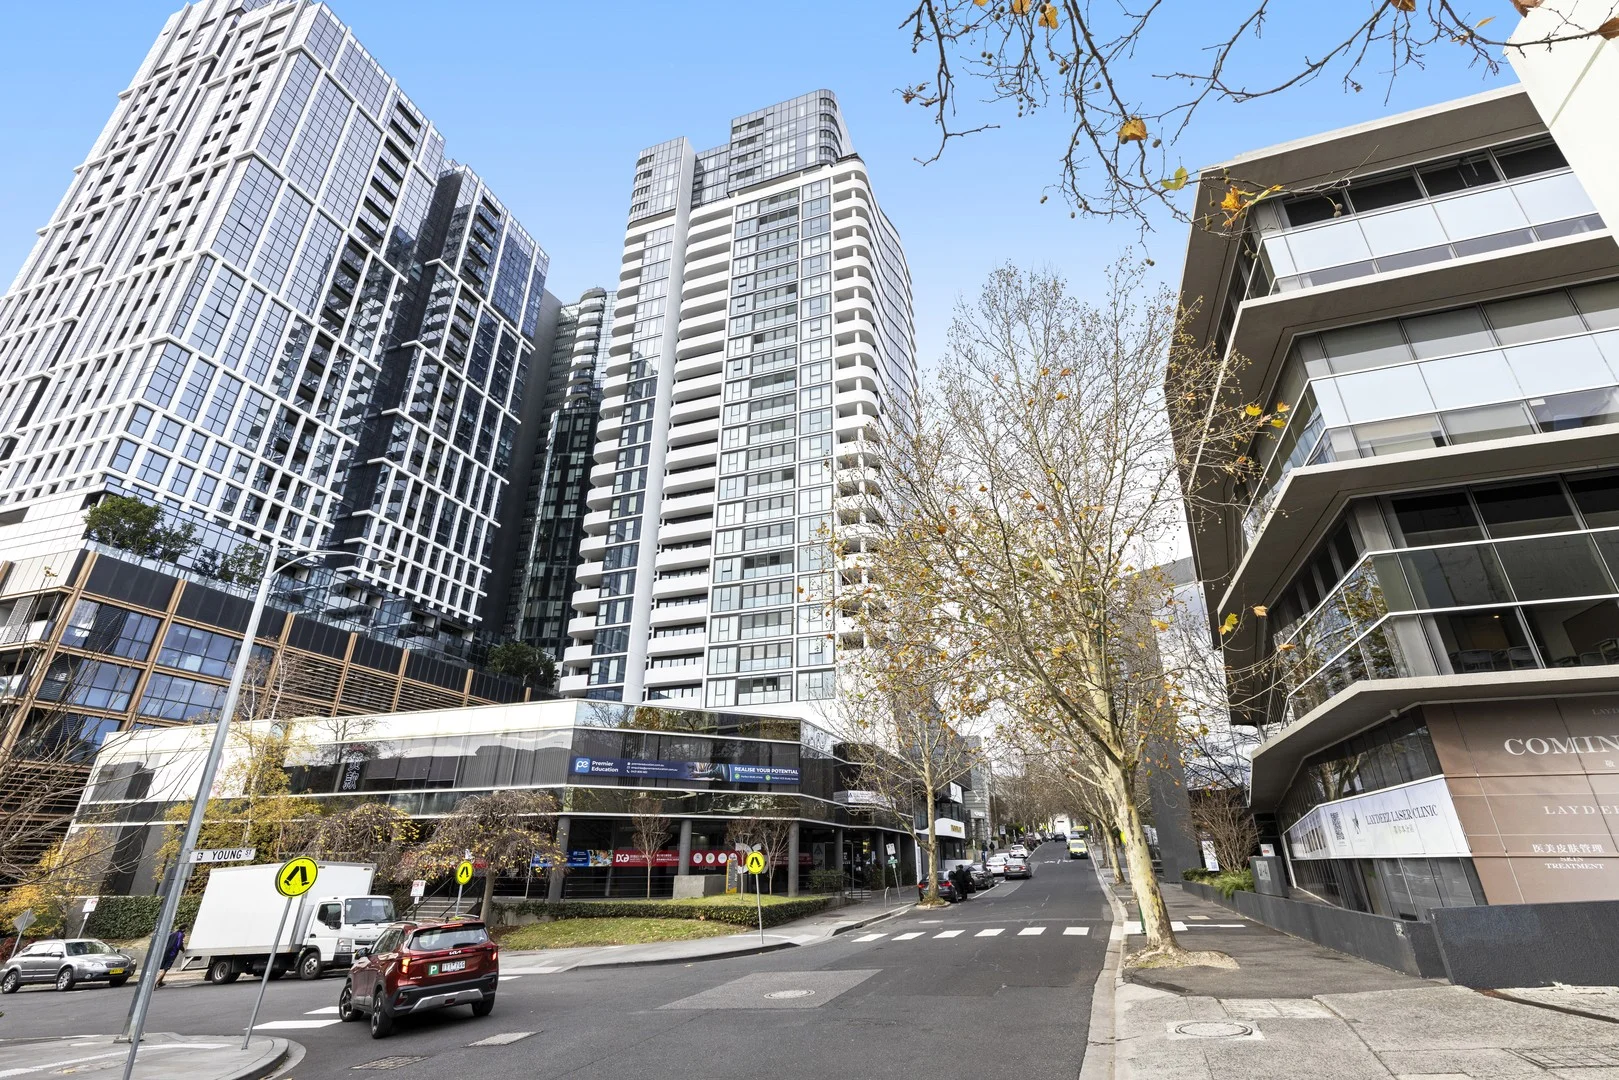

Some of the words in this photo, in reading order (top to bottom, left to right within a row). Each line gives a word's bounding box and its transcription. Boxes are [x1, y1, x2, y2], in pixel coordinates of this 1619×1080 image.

[1365, 811, 1391, 825] LAYDEEZ
[1391, 808, 1414, 822] LASER
[1413, 804, 1438, 819] CLINIC
[1532, 843, 1605, 854] 医美皮肤管理
[212, 849, 243, 860] YOUNG
[430, 965, 437, 974] P
